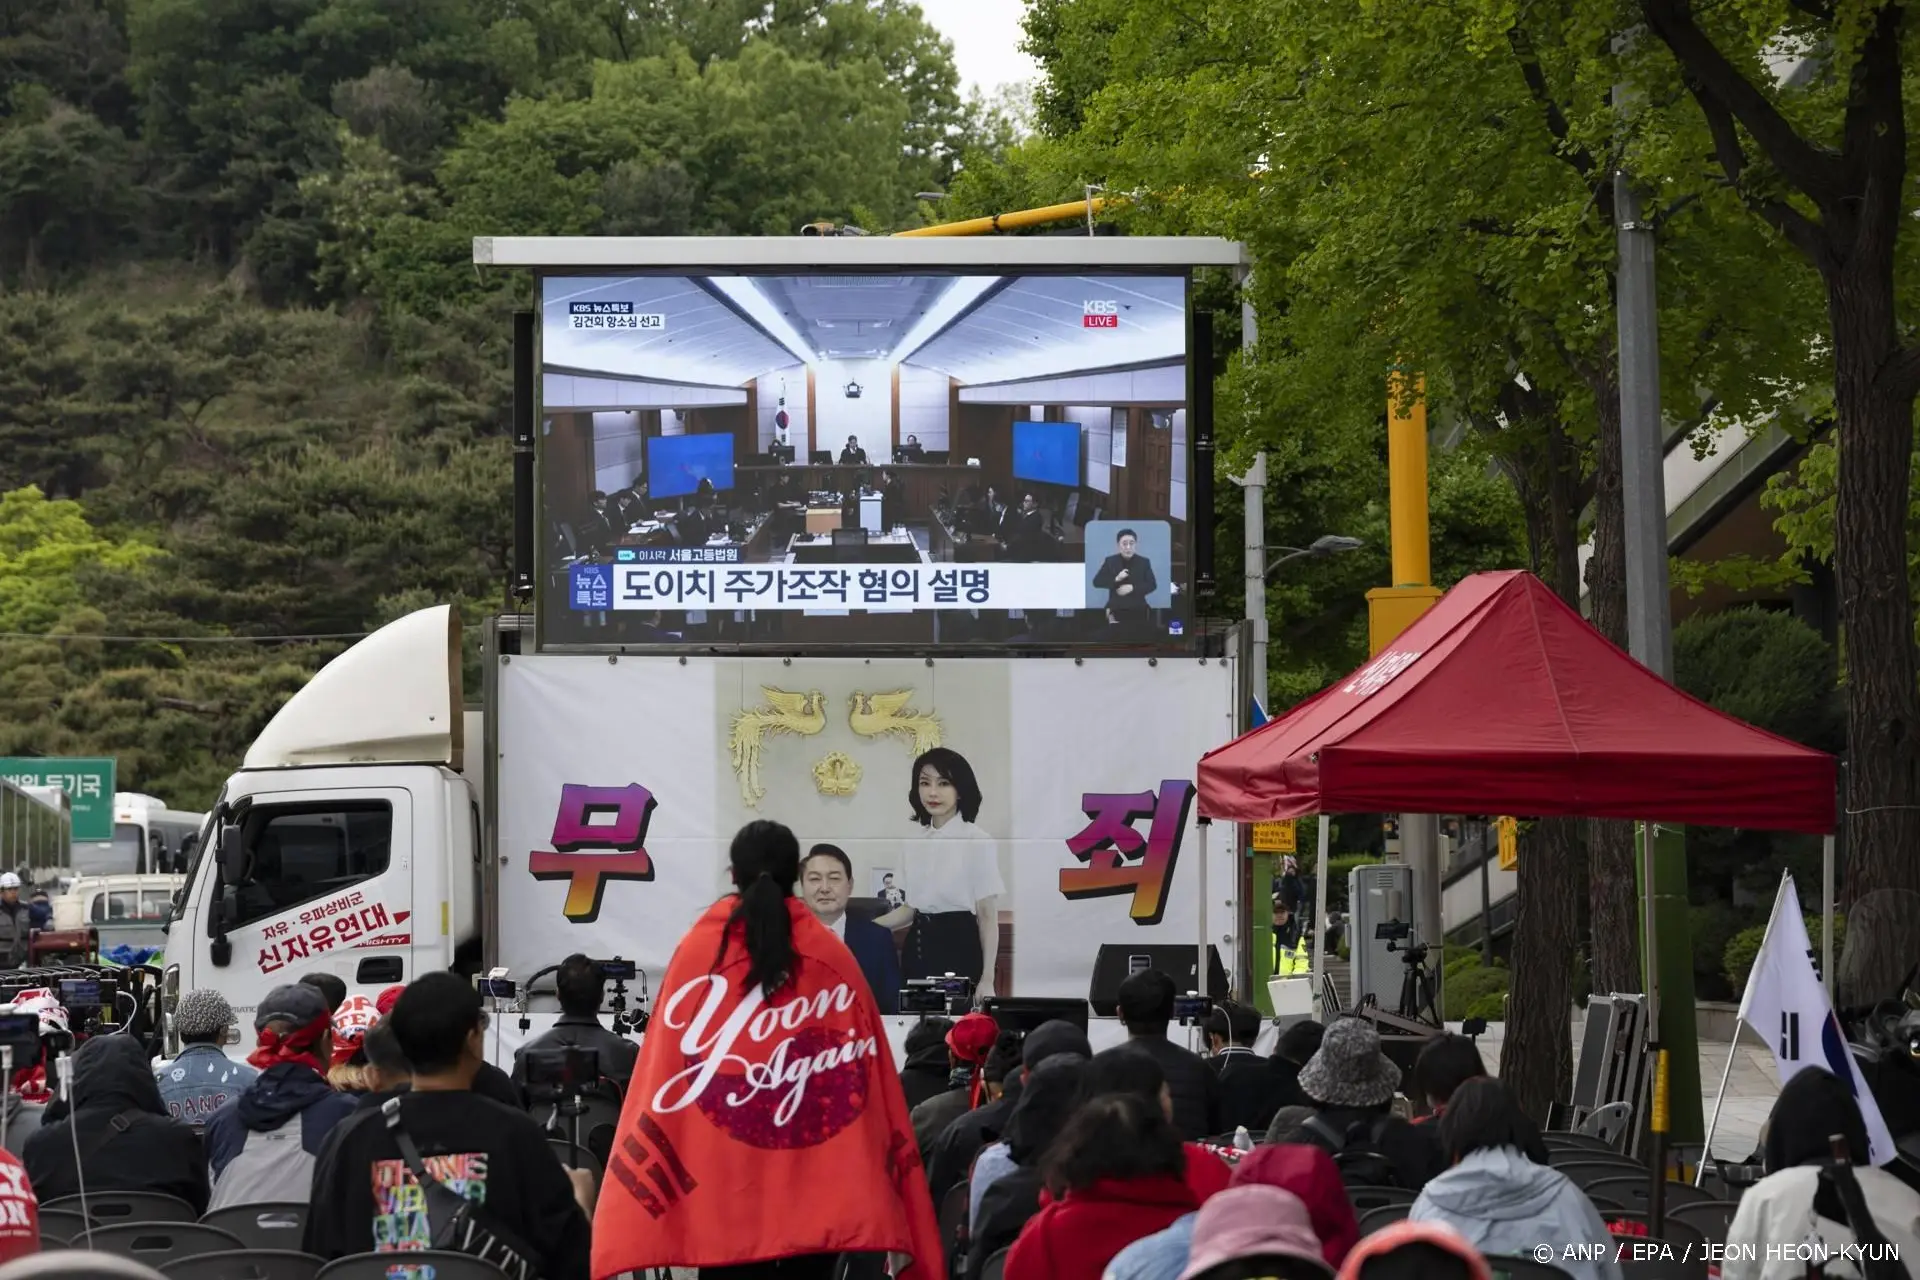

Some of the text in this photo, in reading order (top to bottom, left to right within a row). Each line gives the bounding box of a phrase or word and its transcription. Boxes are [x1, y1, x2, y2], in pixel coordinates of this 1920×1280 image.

[573, 303, 629, 313] KBS 뉴스특보
[1083, 300, 1118, 314] KBS
[573, 316, 661, 328] 김건희 항소심 선고
[1088, 316, 1113, 326] LIVE
[669, 549, 738, 561] 서울고등법원
[576, 574, 607, 589] 뉴스
[622, 569, 990, 604] 도이치 주가조작 혐의 설명
[576, 590, 607, 606] 특보
[529, 779, 1196, 926] 무 죄
[300, 891, 364, 925] 우파상비군
[258, 903, 389, 974] 신자유연대
[652, 975, 856, 1113] Yoon
[726, 1028, 877, 1127] Again
